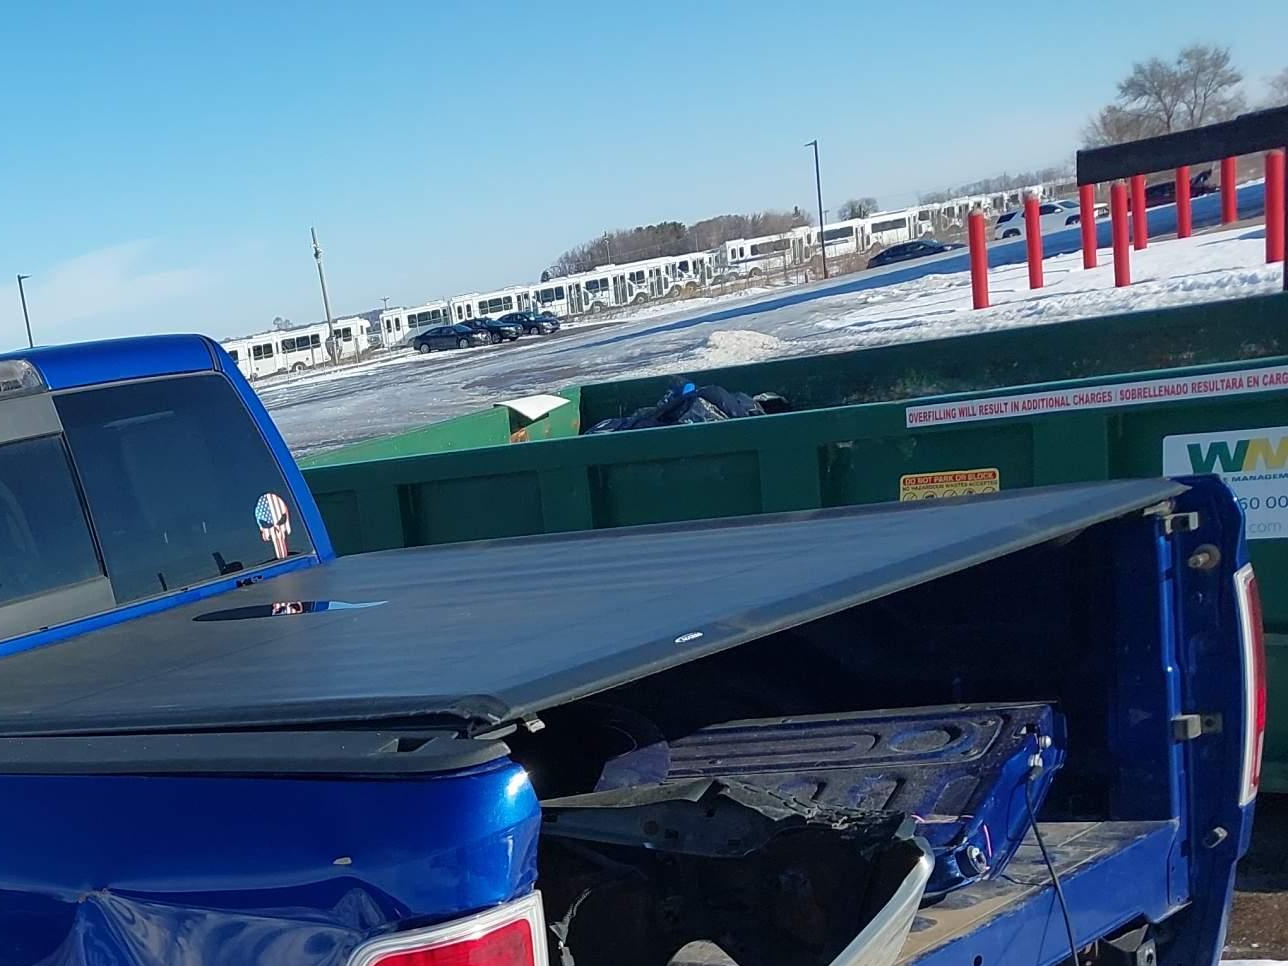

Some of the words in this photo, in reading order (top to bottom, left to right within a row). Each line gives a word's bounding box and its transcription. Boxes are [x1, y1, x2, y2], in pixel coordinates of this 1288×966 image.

[908, 407, 957, 424] OVERFILLING
[958, 403, 977, 418] WILL
[978, 402, 1009, 416] RESULT
[1010, 400, 1020, 412] IN
[1021, 395, 1071, 412] ADDITIONAL
[1072, 391, 1113, 406] CHARGES
[1119, 382, 1189, 401] SOBRELLENADO
[1246, 374, 1260, 388] EN
[1262, 371, 1288, 386] CARG
